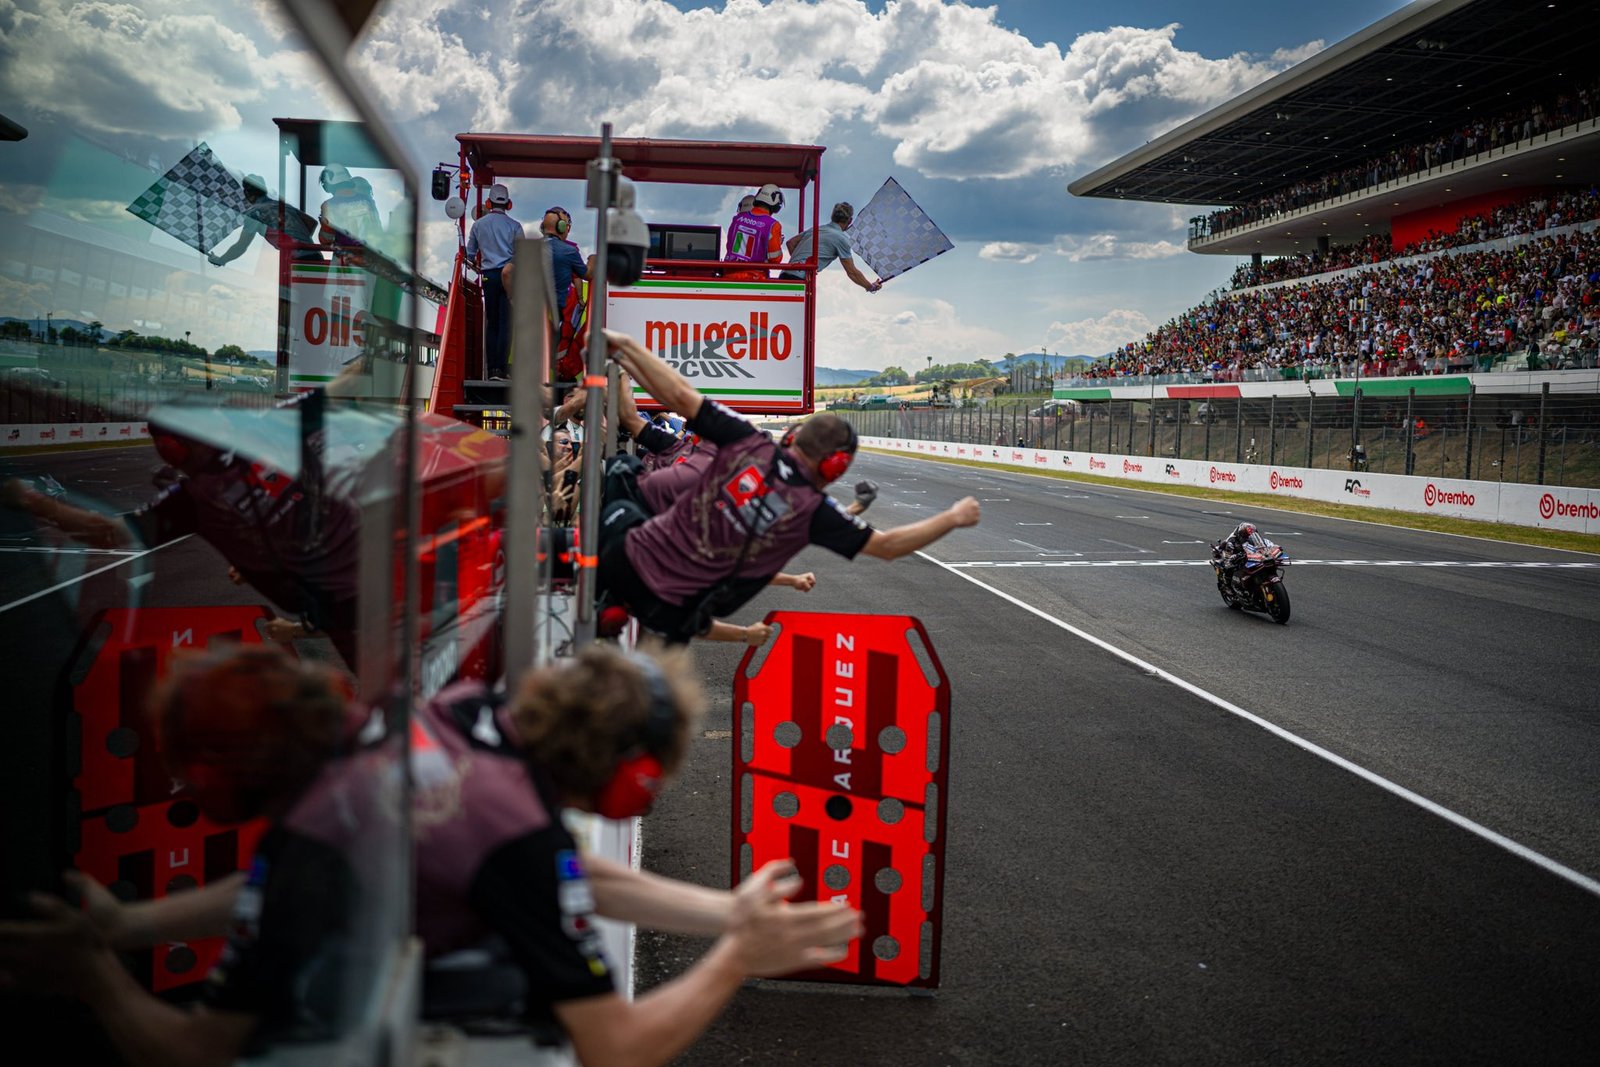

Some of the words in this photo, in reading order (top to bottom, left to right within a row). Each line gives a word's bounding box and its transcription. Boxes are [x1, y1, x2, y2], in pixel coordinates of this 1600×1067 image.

[645, 311, 792, 361] mugello
[1216, 471, 1237, 483] brembo
[1278, 476, 1304, 489] brembo
[1437, 488, 1475, 506] brembo
[1557, 499, 1600, 519] bremb
